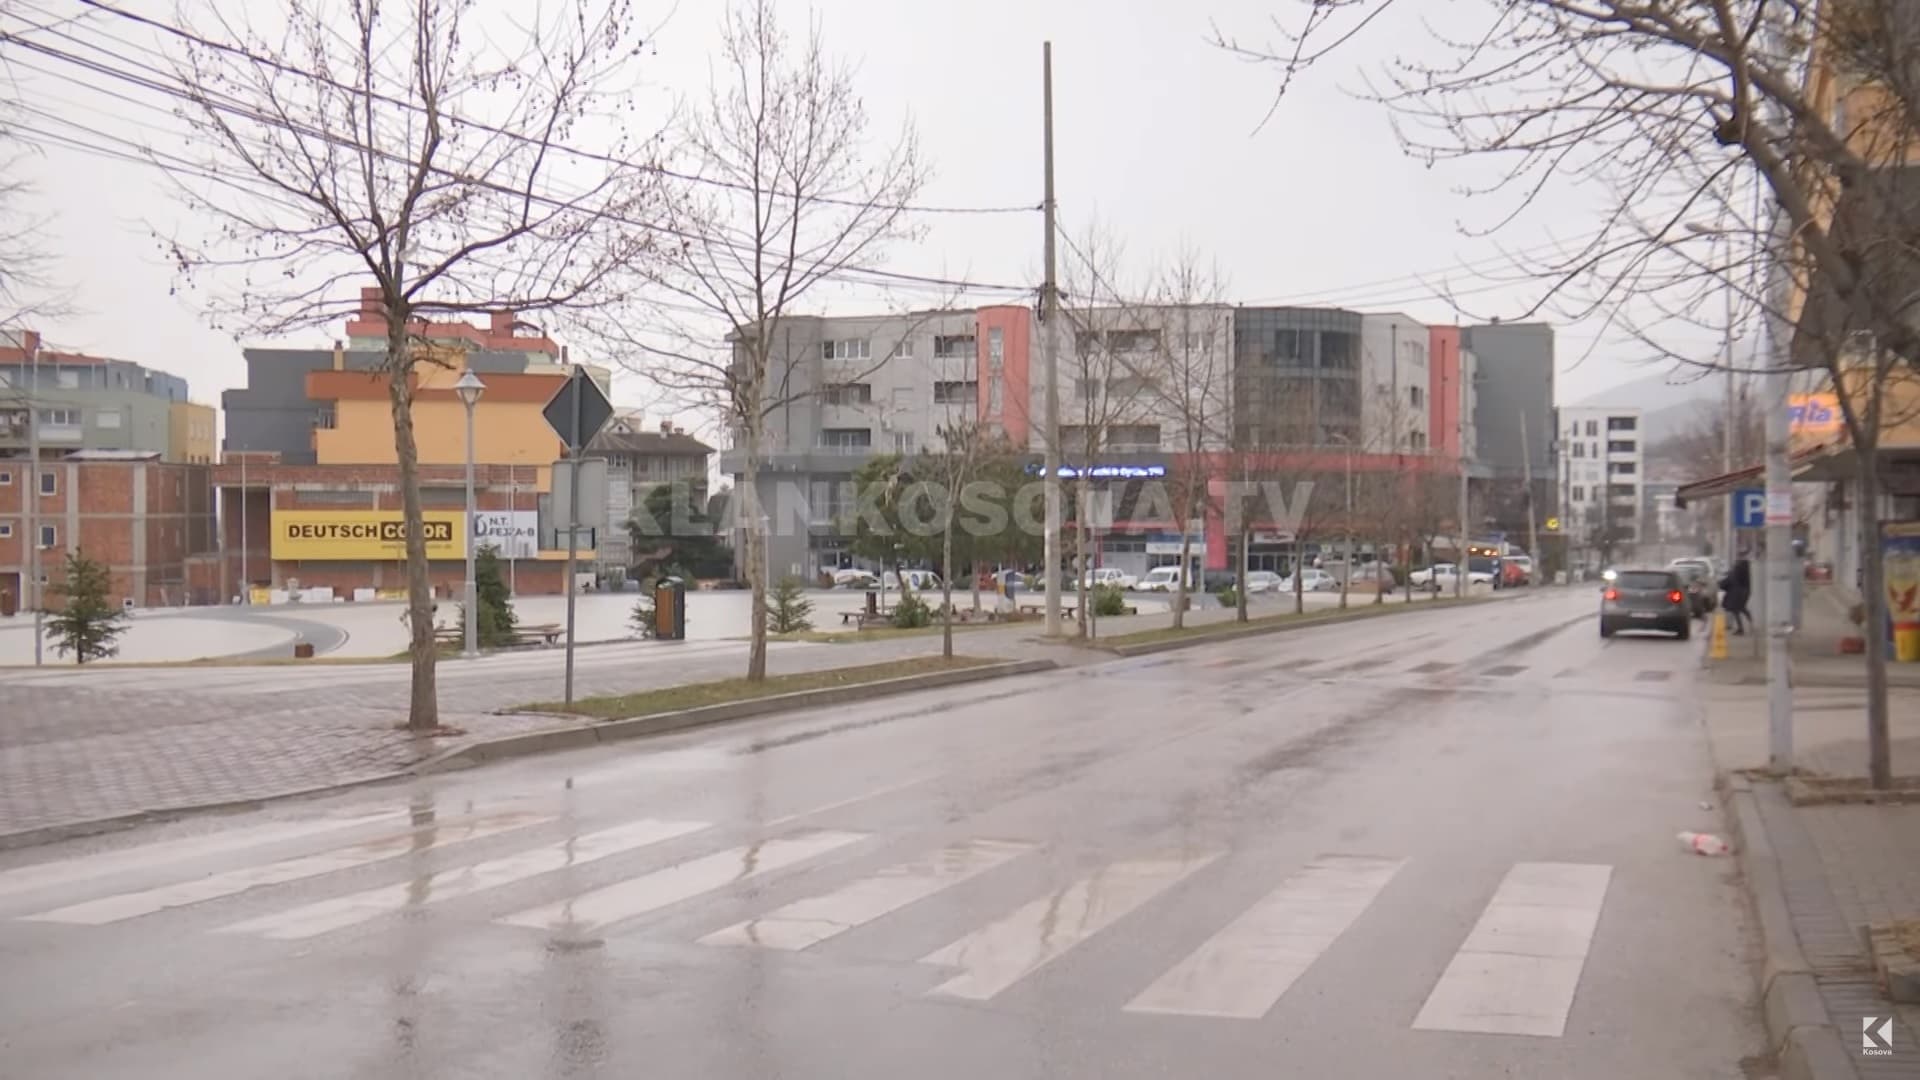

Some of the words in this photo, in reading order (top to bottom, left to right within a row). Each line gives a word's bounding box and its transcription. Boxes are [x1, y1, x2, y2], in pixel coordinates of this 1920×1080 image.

[1744, 496, 1765, 523] P
[288, 524, 378, 538] DEUTSCH
[383, 523, 449, 538] COOR
